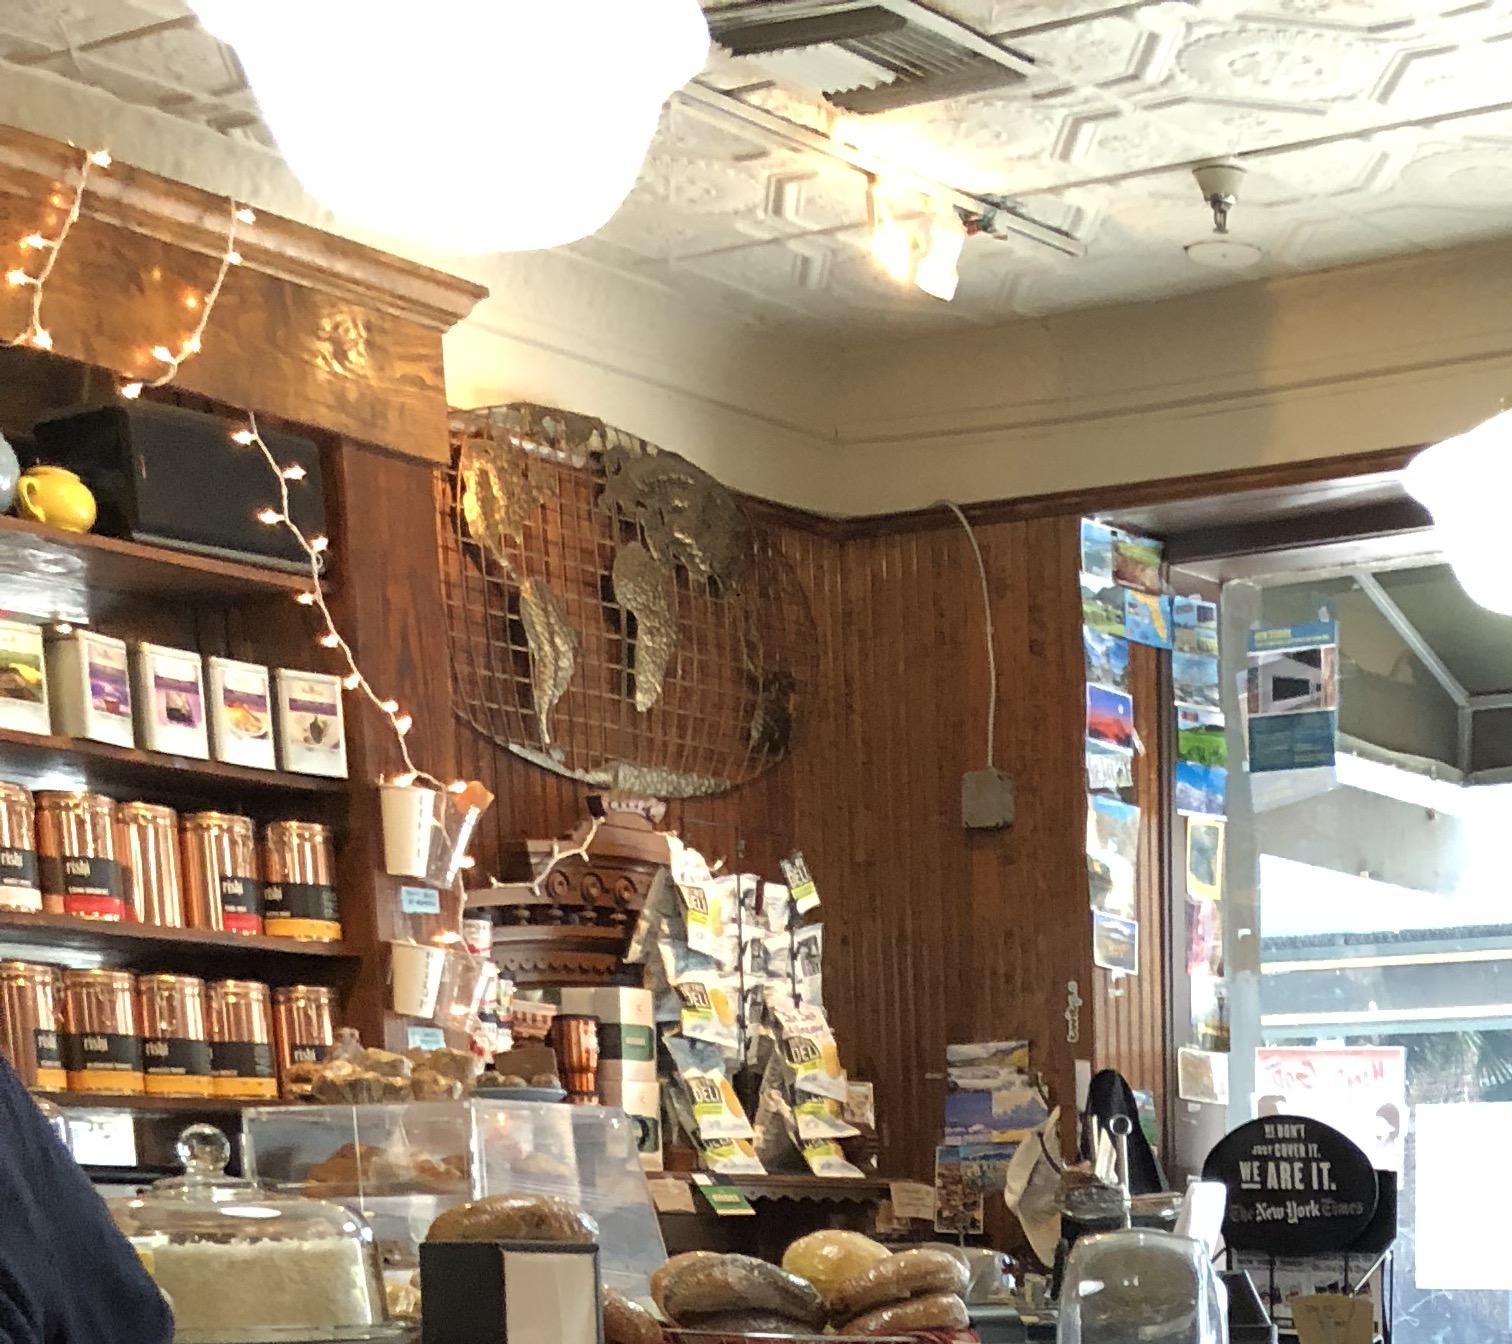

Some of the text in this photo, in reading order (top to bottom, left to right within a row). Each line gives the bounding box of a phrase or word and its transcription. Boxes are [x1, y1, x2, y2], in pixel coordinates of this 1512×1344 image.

[1277, 1124, 1305, 1139] DON'T
[1274, 1143, 1306, 1158] COVER
[1239, 1161, 1337, 1190] WE ARE IT.
[1256, 1202, 1284, 1222] New
[1286, 1200, 1320, 1224] York
[1321, 1198, 1363, 1216] Times
